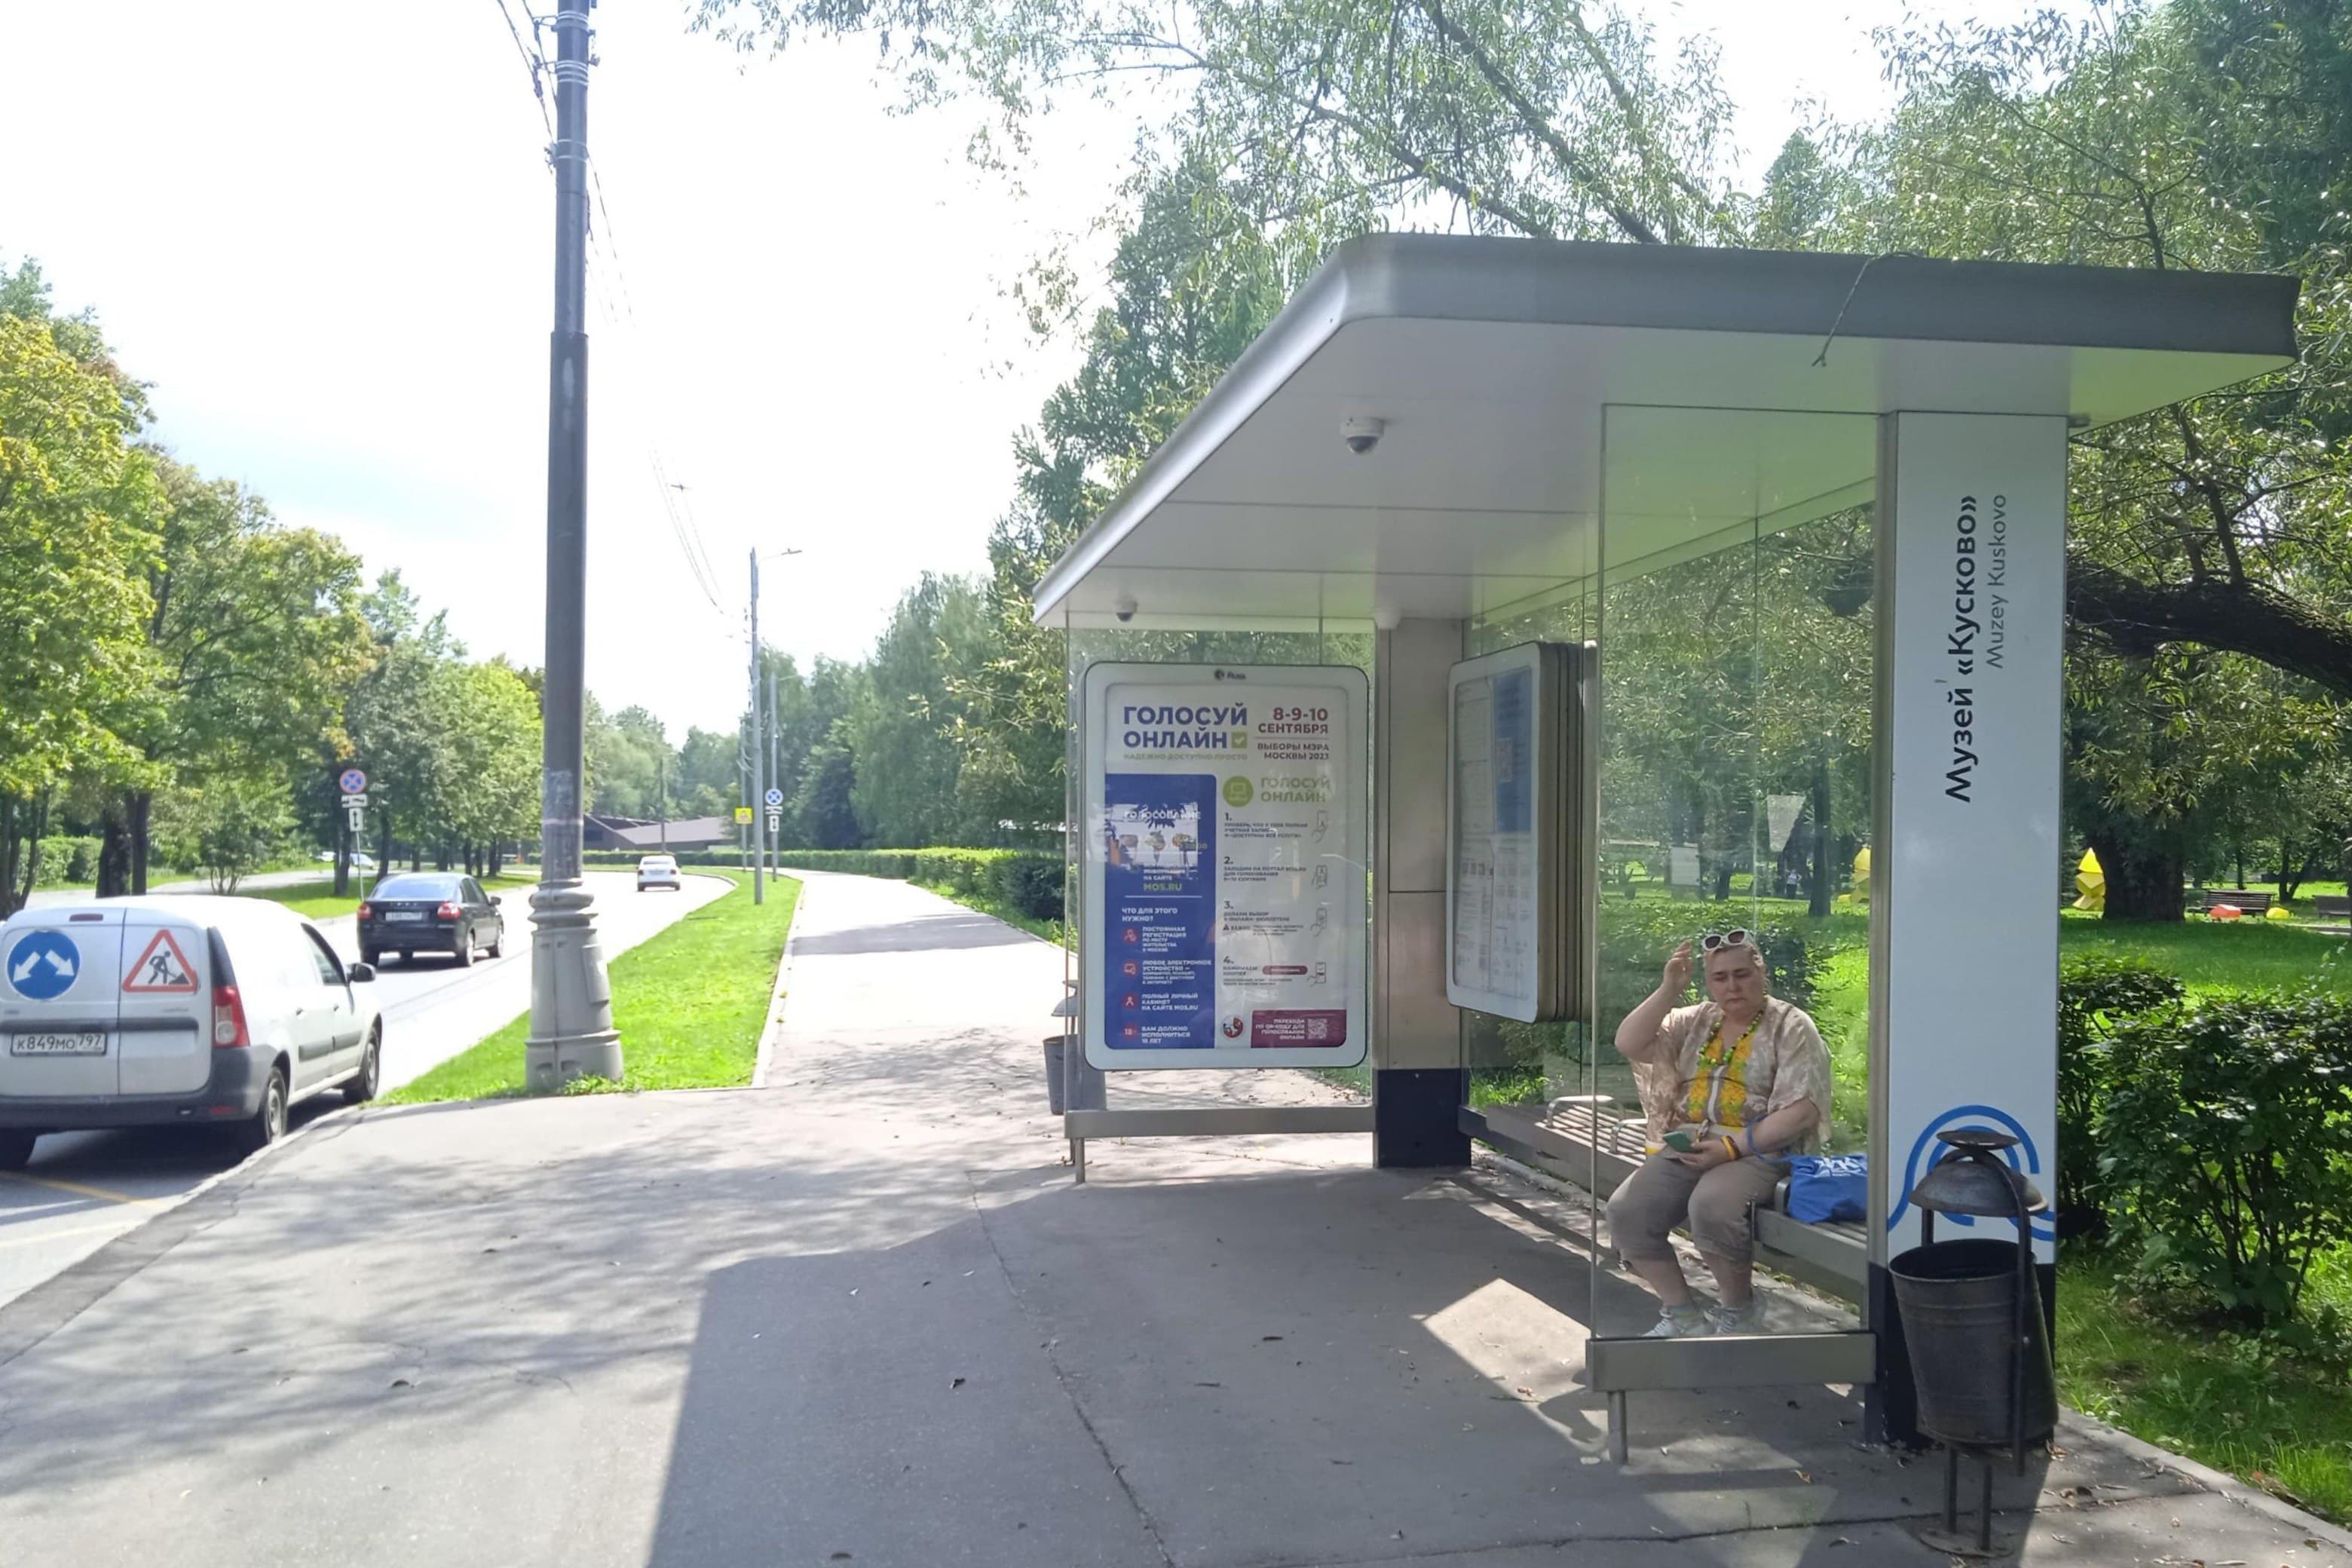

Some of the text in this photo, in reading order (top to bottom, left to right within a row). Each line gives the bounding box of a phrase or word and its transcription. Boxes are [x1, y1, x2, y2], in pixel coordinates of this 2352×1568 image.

[1986, 494, 2009, 669] Muzey Kuskovo
[1945, 495, 1980, 803] Музей «Кусково»
[1123, 703, 1248, 726] ГОЛОСУЙ
[1272, 707, 1328, 721] 8-9-10
[1258, 723, 1328, 734] СЕНТЯБРЯ
[1123, 727, 1228, 749] ОНЛАЙН
[1257, 743, 1329, 751] ВЫБОРЫ МЭРА
[1263, 752, 1329, 760] МОСКВЫ 2023
[1260, 775, 1331, 789] ГОЛОСУЙ
[1260, 789, 1326, 803] ОНЛАЙН
[1224, 812, 1233, 821] 1.
[1223, 856, 1233, 865] 2.
[1144, 883, 1183, 892] MOS.RU
[1223, 901, 1234, 909] 3.
